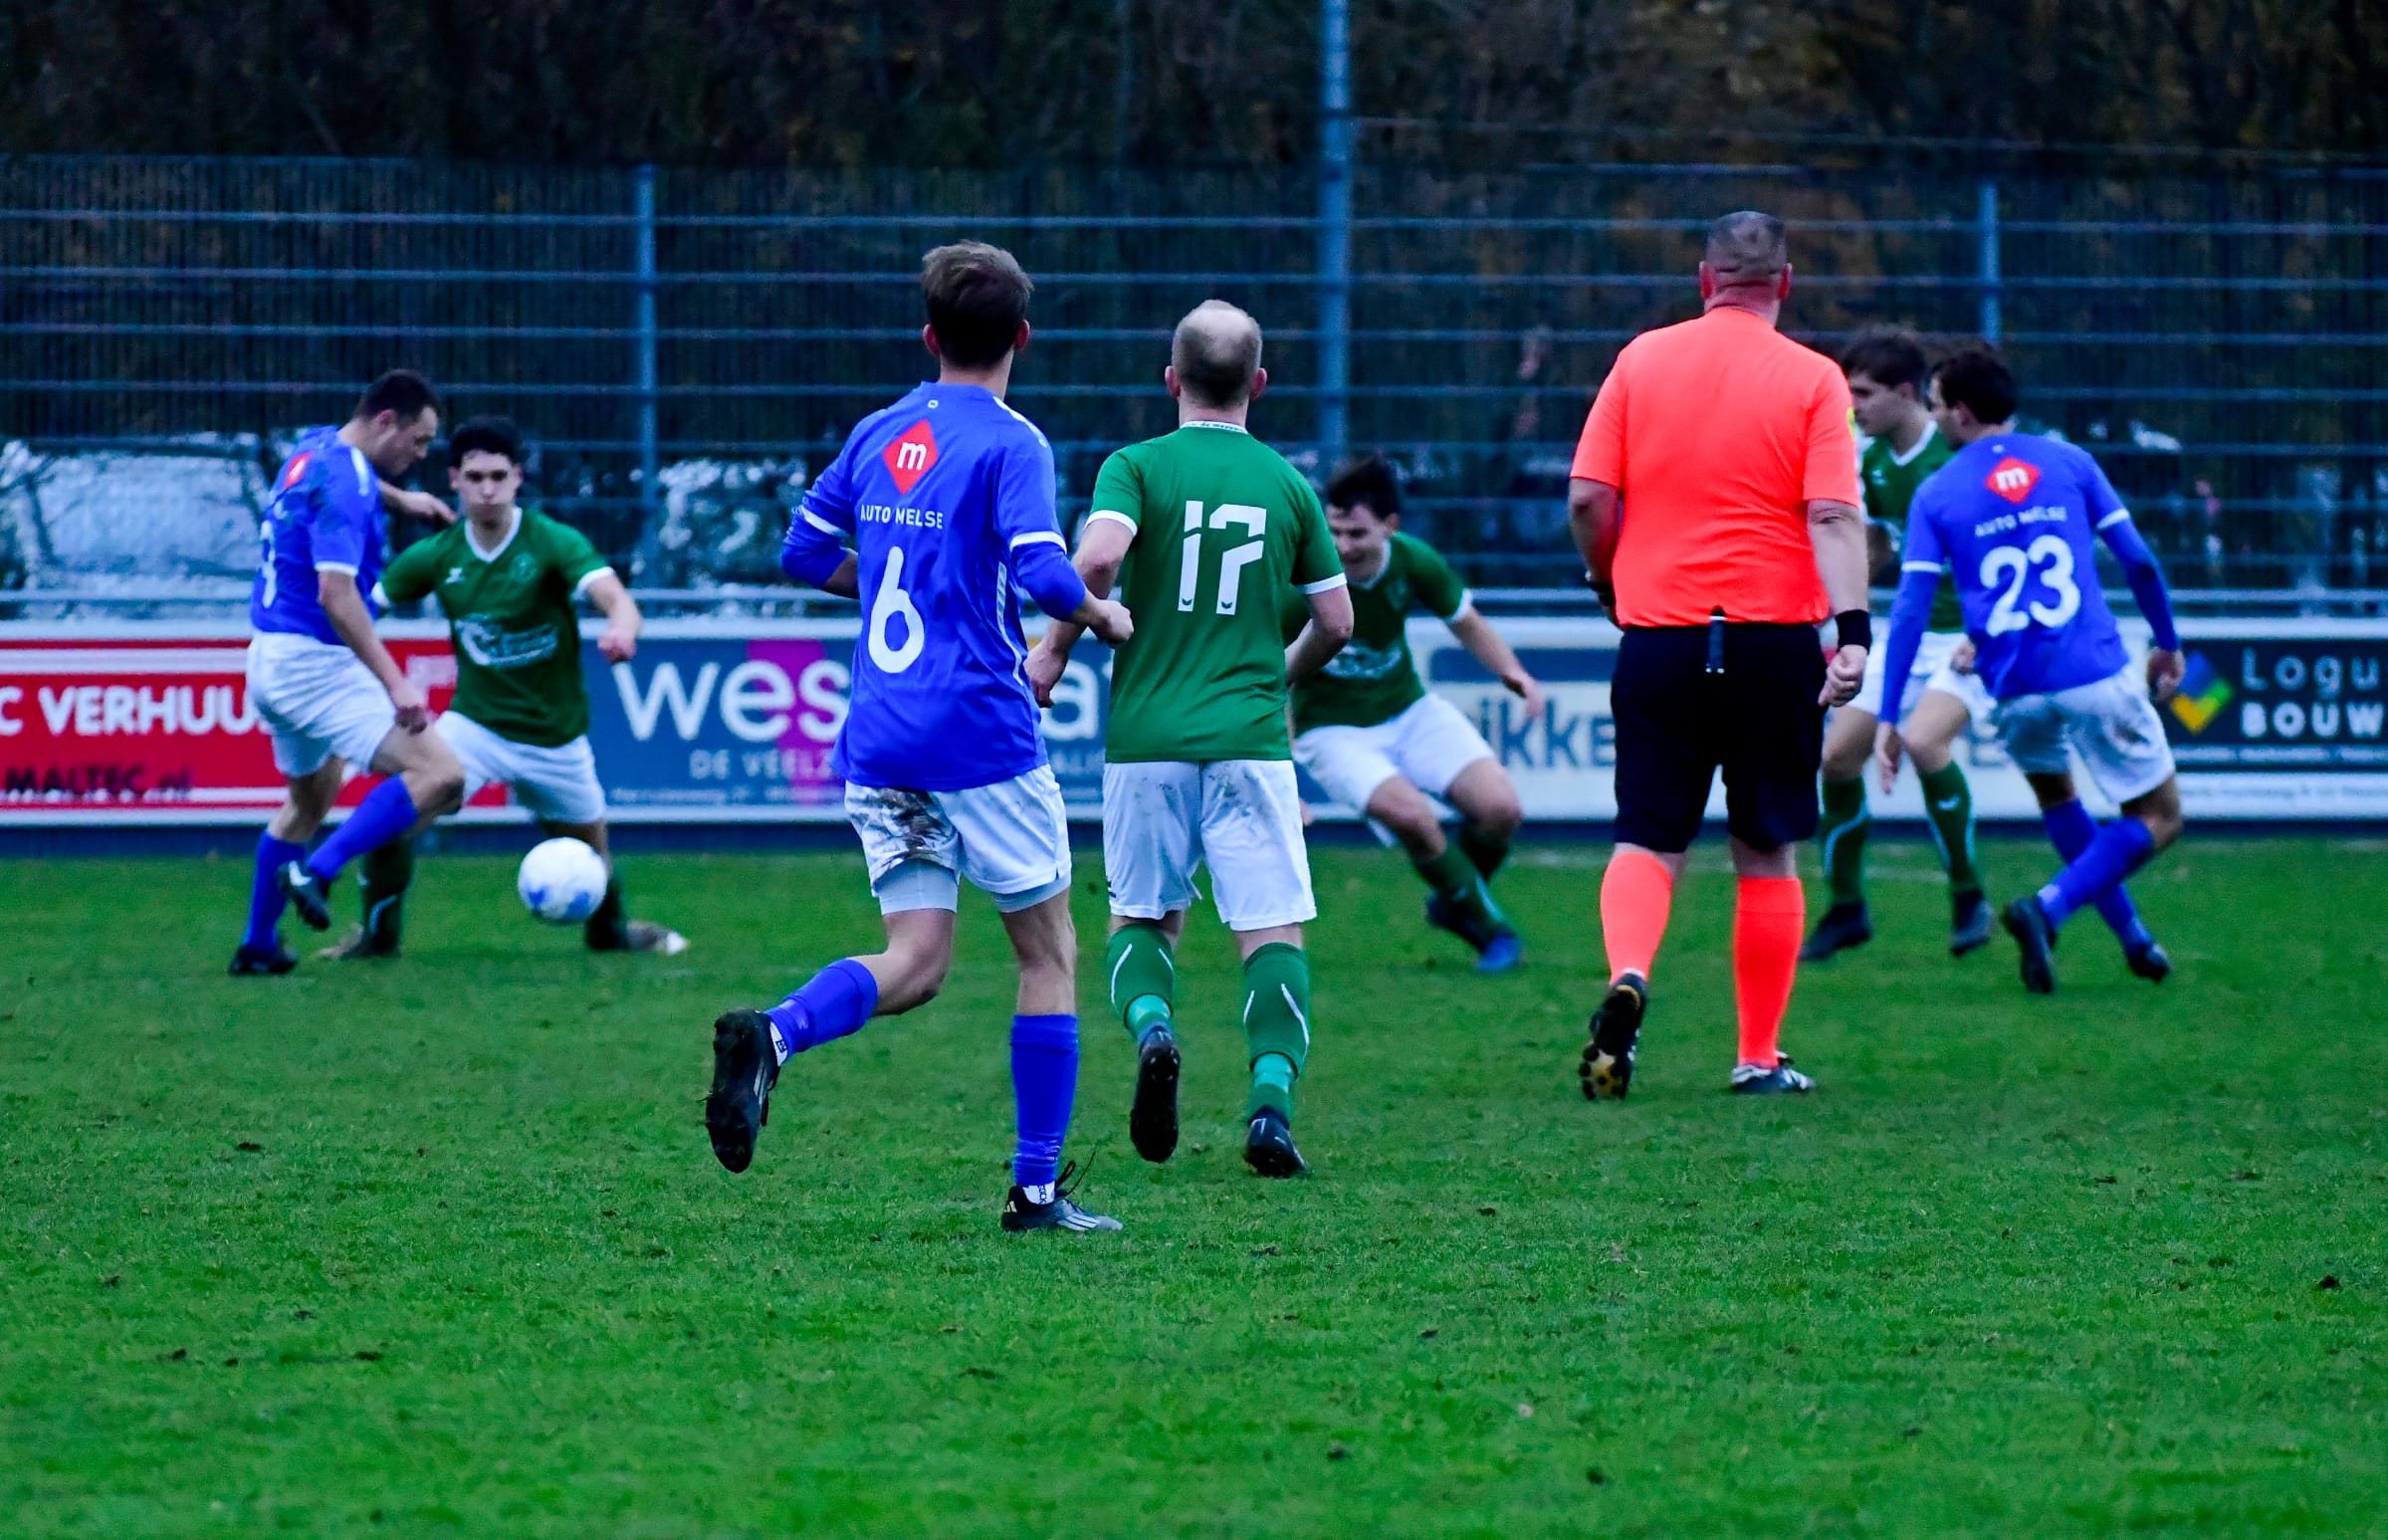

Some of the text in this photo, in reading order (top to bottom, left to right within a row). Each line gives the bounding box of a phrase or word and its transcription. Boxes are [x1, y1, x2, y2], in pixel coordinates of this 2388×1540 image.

[896, 441, 928, 471] m
[860, 504, 891, 524] AUTO
[1178, 500, 1267, 615] 17
[1979, 534, 2081, 637] 23
[868, 546, 925, 673] 6
[37, 685, 272, 737] VERHUU
[2241, 701, 2385, 739] BOUW
[689, 749, 730, 779] DE
